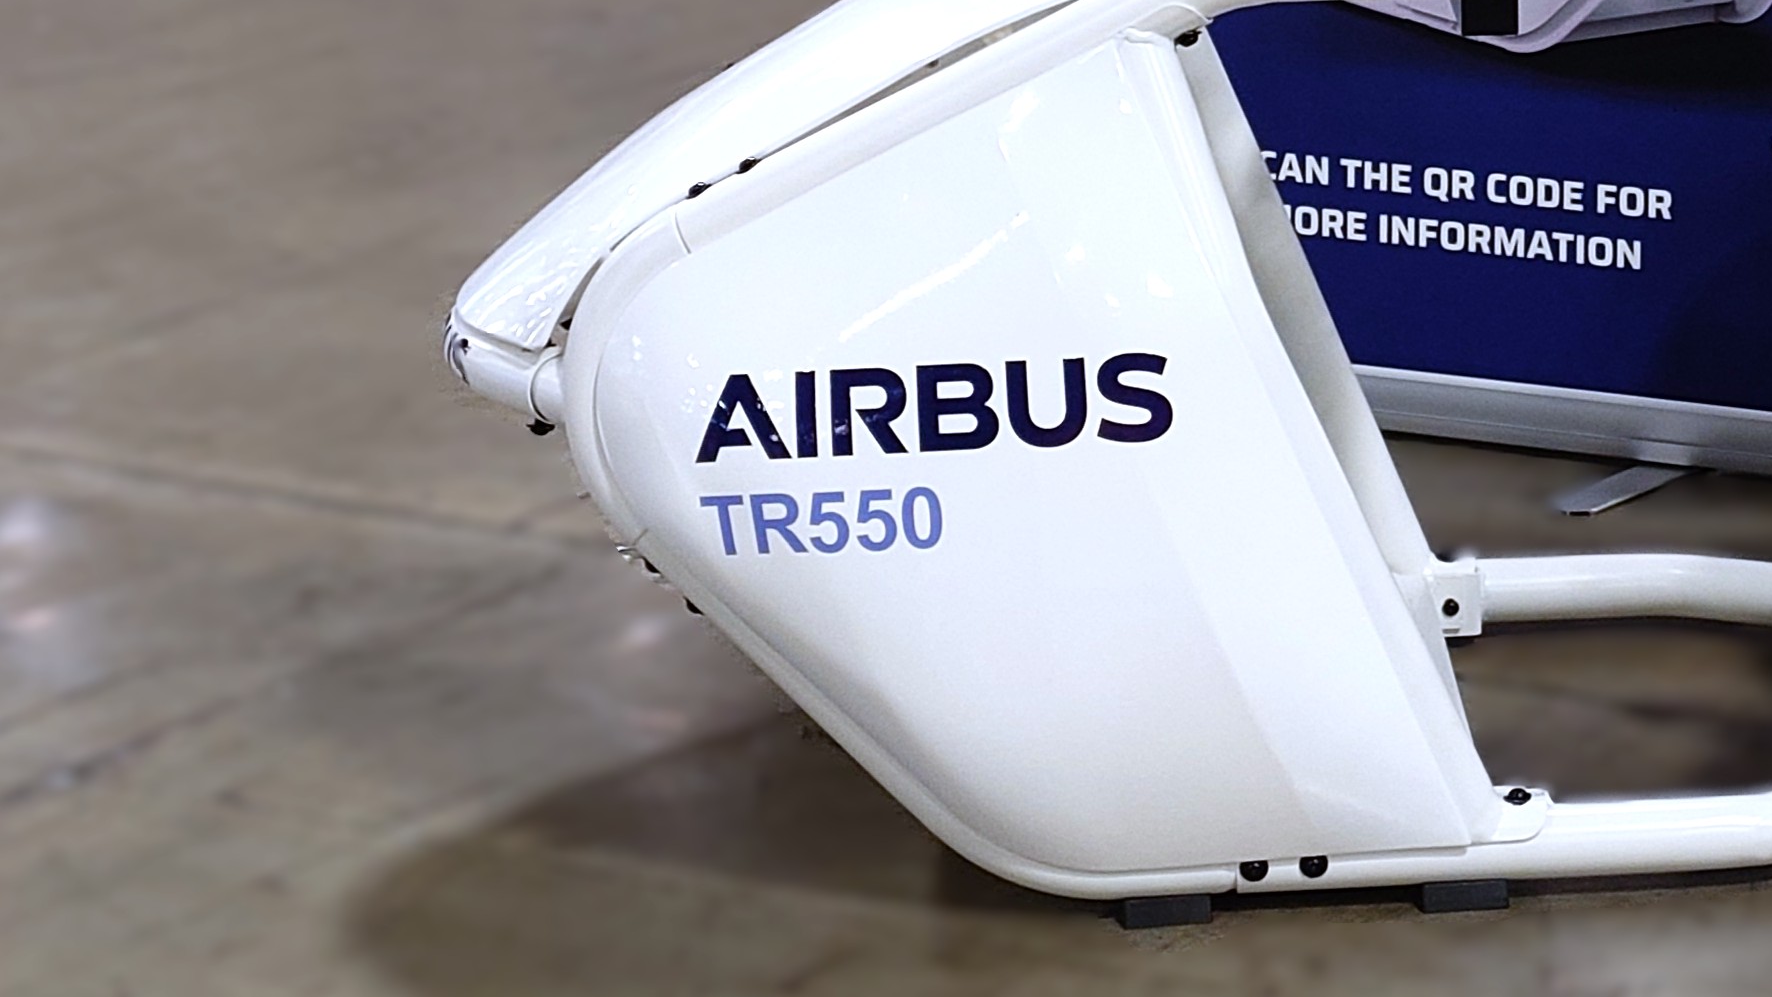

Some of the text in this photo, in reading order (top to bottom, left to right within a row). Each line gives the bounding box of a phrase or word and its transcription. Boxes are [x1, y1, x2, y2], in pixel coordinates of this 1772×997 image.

[1260, 151, 1672, 220] CAN THE QR CODE FOR
[1284, 204, 1642, 270] ORE INFORMATION
[695, 352, 1174, 464] AIRBUS
[699, 486, 943, 557] TR550
